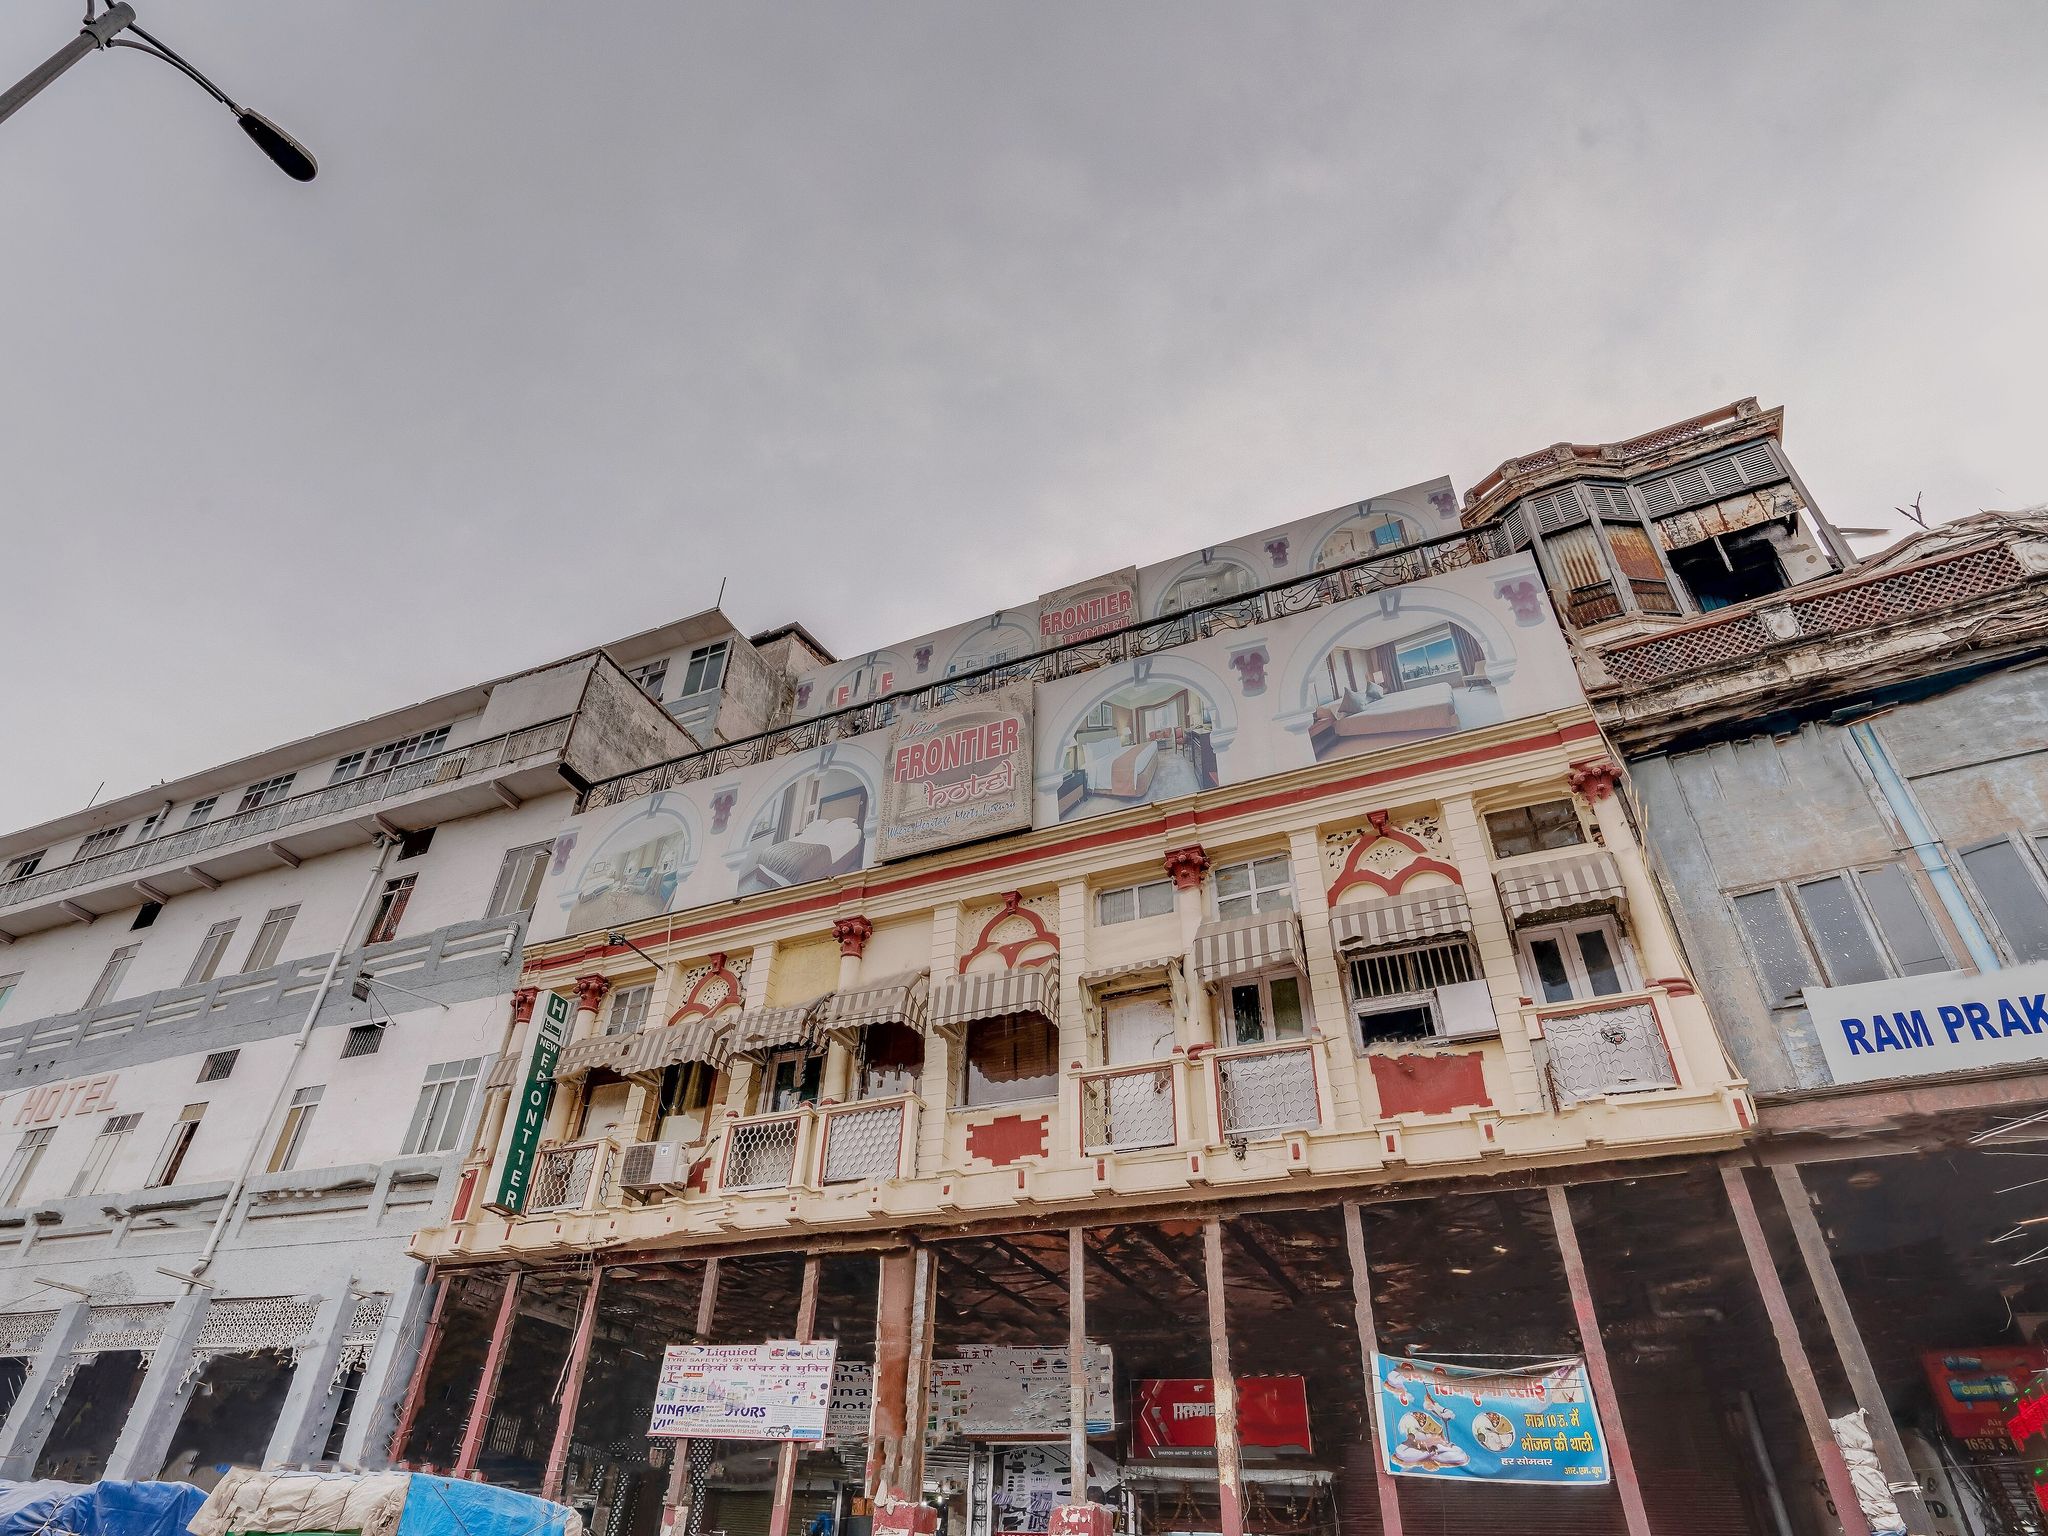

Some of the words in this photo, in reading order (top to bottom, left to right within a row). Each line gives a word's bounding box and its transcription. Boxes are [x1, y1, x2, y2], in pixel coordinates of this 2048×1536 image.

[1040, 590, 1132, 636] FRONTIER
[901, 721, 938, 741] New
[893, 717, 1020, 784] FRONTIER
[925, 759, 1018, 810] hotel
[551, 998, 566, 1021] H
[1840, 1009, 1935, 1056] RAM
[539, 1036, 559, 1054] NEW
[12, 1074, 119, 1126] HOTEL
[505, 1052, 552, 1210] FRONTIER
[706, 1347, 757, 1357] Liquied
[664, 1364, 682, 1372] अब
[732, 1363, 744, 1372] के
[748, 1364, 776, 1372] पंचर
[780, 1364, 791, 1372] से
[1524, 1413, 1545, 1428] मात्र
[1546, 1414, 1557, 1427] 10
[1569, 1408, 1580, 1427] में
[1521, 1432, 1553, 1452] भोजन
[1554, 1431, 1569, 1452] की
[1964, 1438, 1995, 1450] 1653
[1500, 1458, 1514, 1466] हर
[1516, 1456, 1553, 1466] सोमवार
